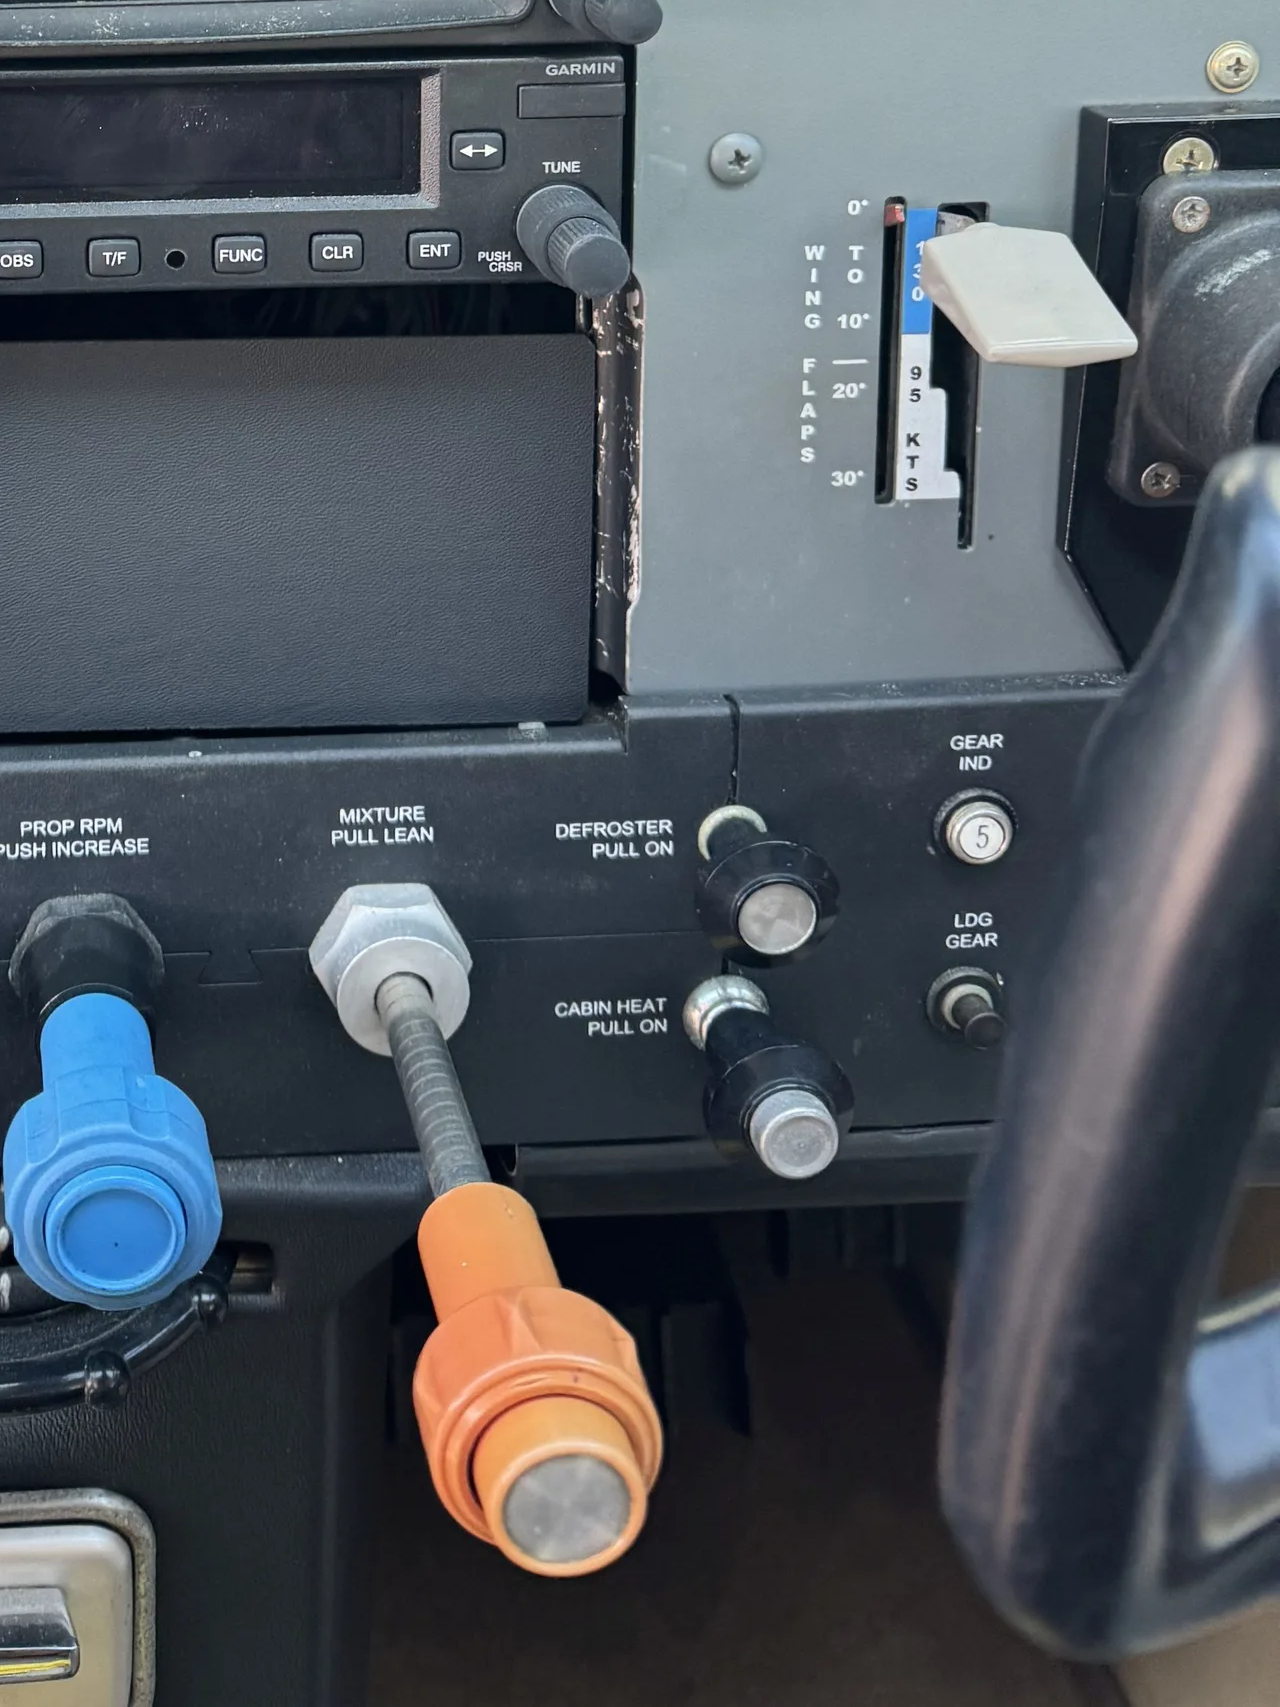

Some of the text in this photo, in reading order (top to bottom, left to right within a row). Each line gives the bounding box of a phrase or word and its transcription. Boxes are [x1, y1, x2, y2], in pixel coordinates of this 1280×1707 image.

[545, 62, 615, 76] GARMIN
[542, 161, 581, 174] TUNE
[102, 251, 127, 266] T/F
[219, 248, 263, 263] FUNC
[322, 245, 353, 260] CLR
[420, 243, 450, 258] ENT
[477, 251, 511, 262] PUSH
[0, 253, 33, 268] OBS
[489, 261, 522, 272] CRSR
[949, 733, 1003, 751] GEAR
[959, 755, 992, 771] IND
[339, 806, 425, 825] MIXTURE
[20, 817, 123, 838] PROP RPM
[331, 825, 434, 846] PULL LEAN
[555, 819, 673, 840] DEFROSTER
[976, 823, 990, 849] 5
[51, 838, 149, 858] INCREASE
[592, 840, 674, 859] PULL ON
[554, 997, 667, 1018] CABIN HEAT
